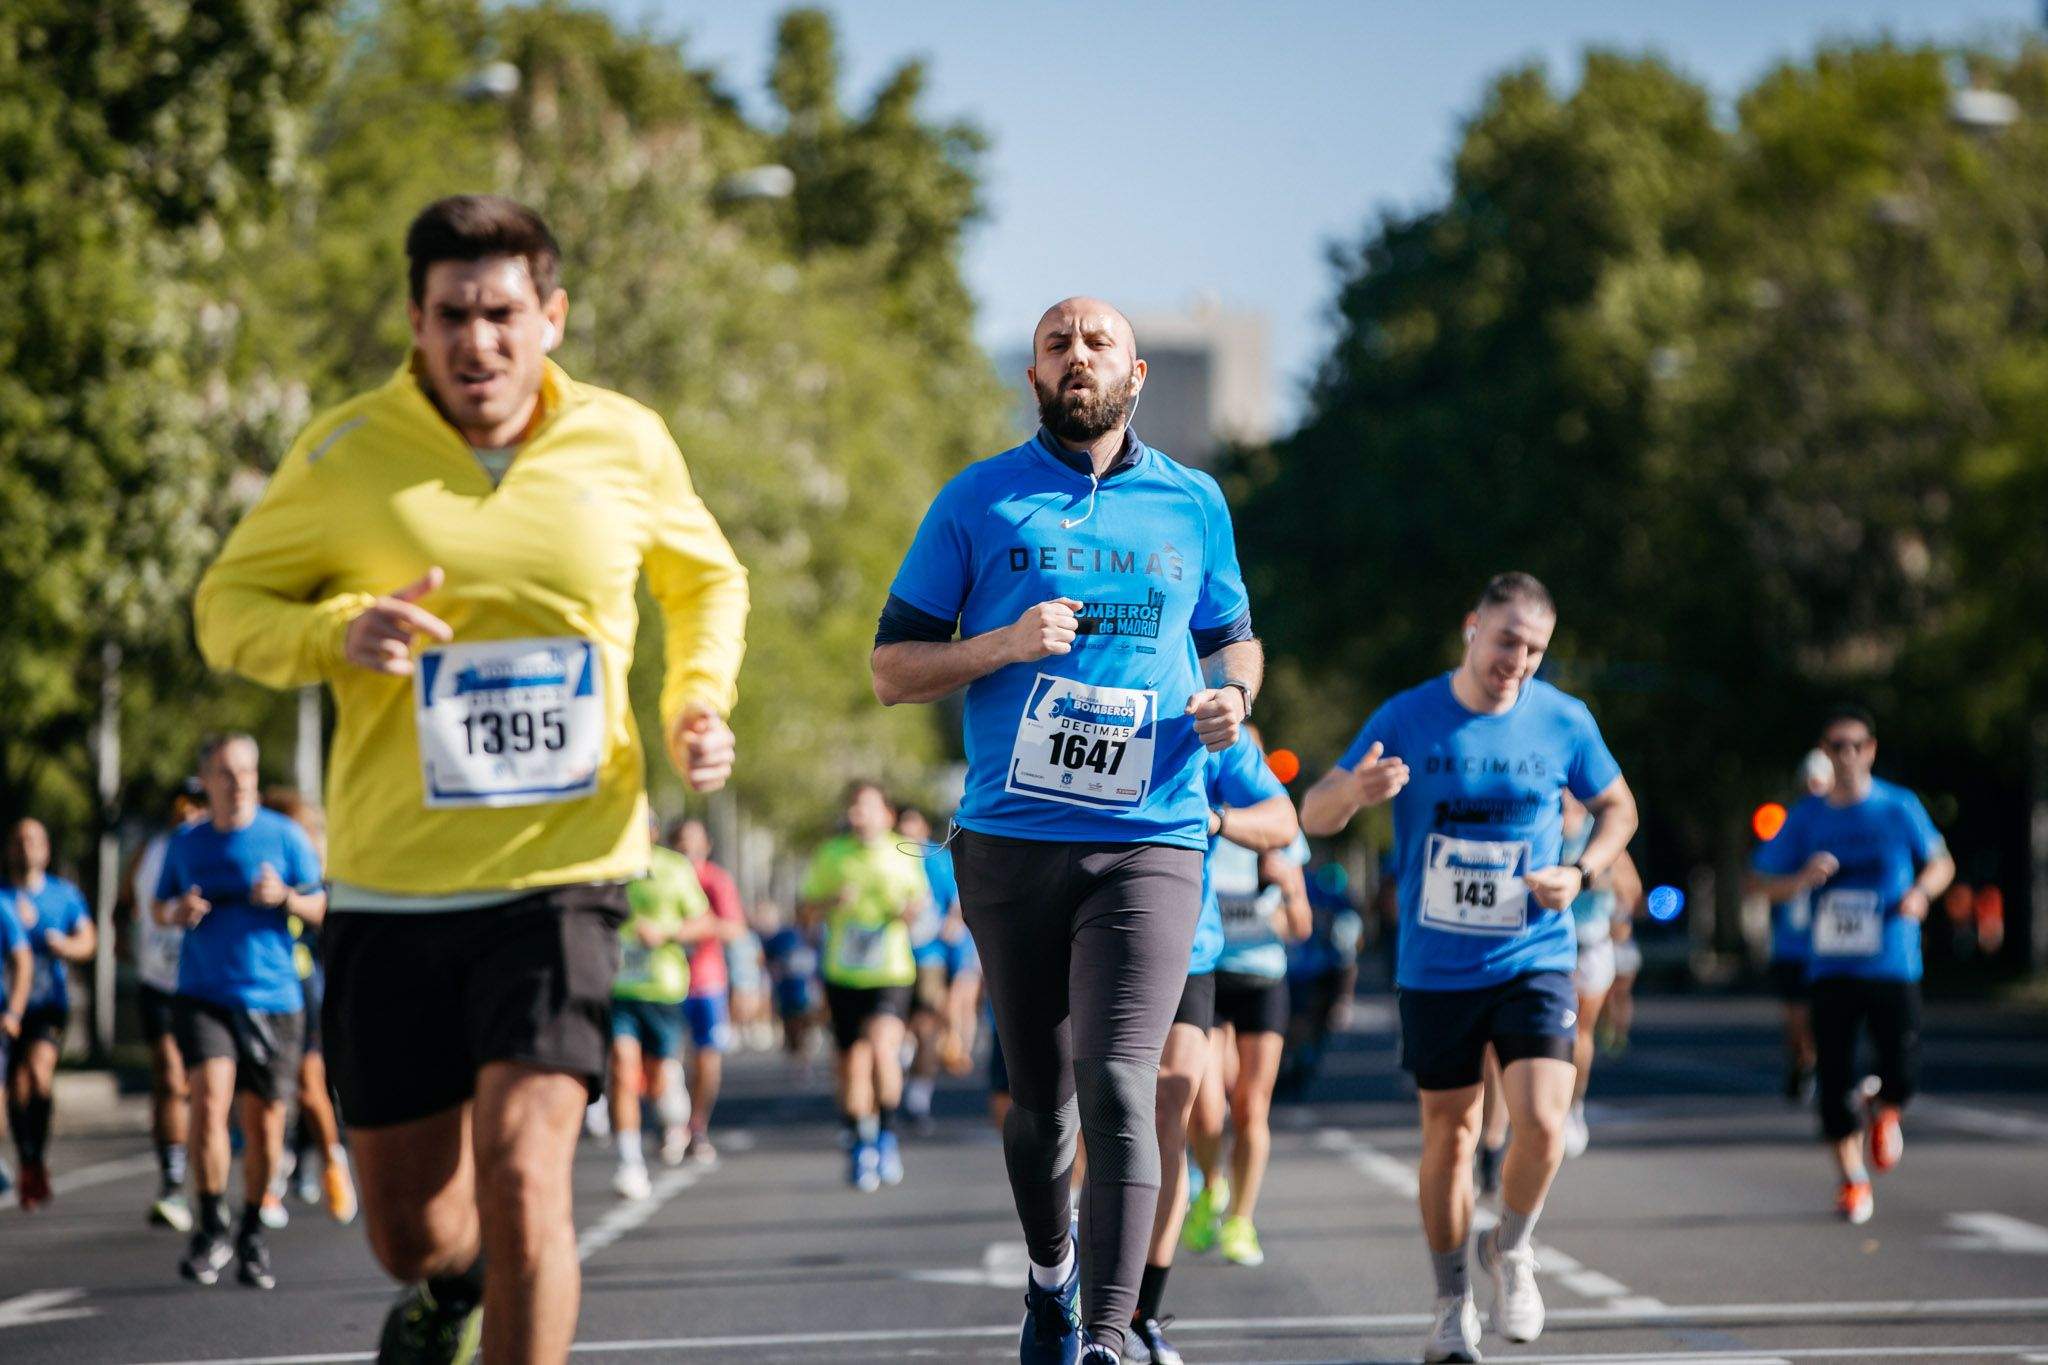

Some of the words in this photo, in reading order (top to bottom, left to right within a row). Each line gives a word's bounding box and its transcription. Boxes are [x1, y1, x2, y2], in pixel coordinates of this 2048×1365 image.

[1009, 546, 1183, 581] DECIMAS
[1099, 619, 1114, 634] de
[1117, 618, 1158, 638] MADRID
[1073, 700, 1134, 717] BOMBEROS
[463, 708, 567, 755] 1395
[1061, 718, 1130, 738] DECIMAS
[1049, 731, 1127, 776] 1647
[1426, 756, 1546, 778] DECIMAS
[1453, 880, 1497, 908] 143
